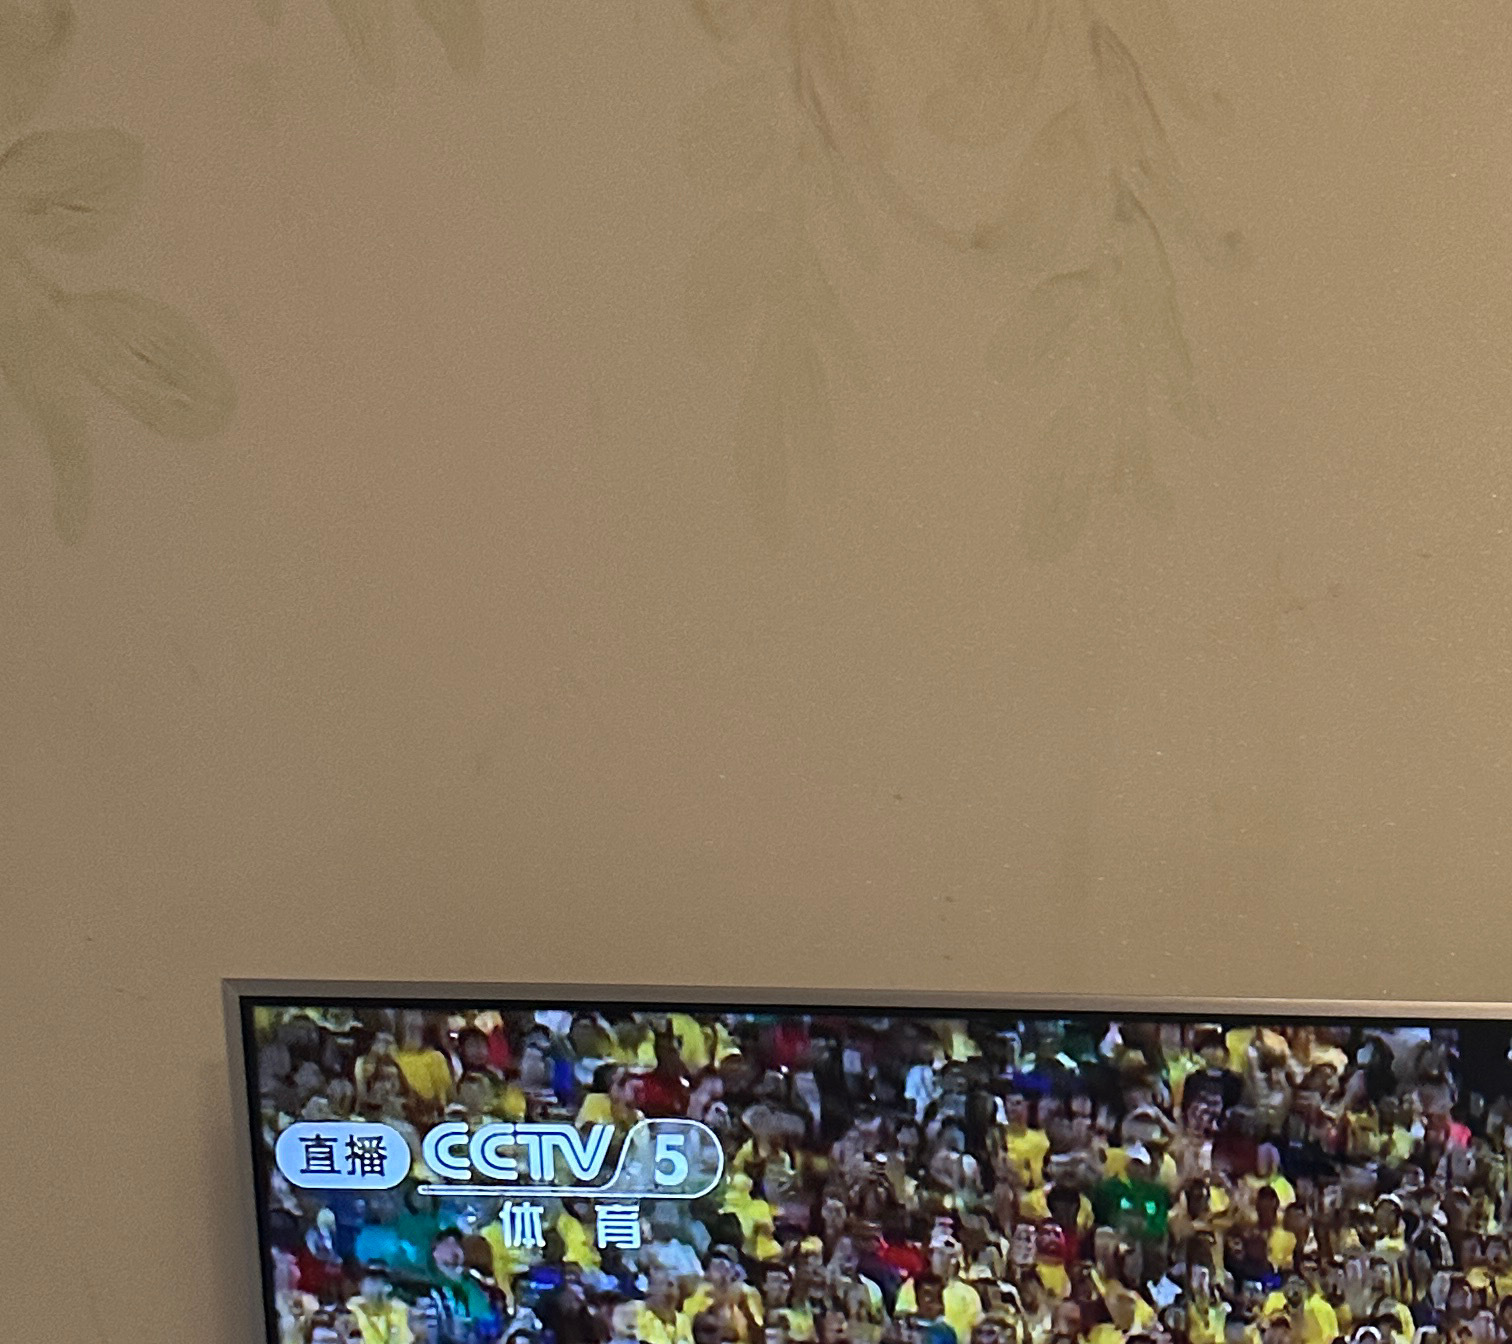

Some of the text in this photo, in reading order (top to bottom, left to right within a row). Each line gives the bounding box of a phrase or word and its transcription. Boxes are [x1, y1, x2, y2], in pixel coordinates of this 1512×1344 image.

[298, 1133, 388, 1178] 直播
[422, 1121, 690, 1187] CCTV 5
[500, 1200, 642, 1250] 体育
